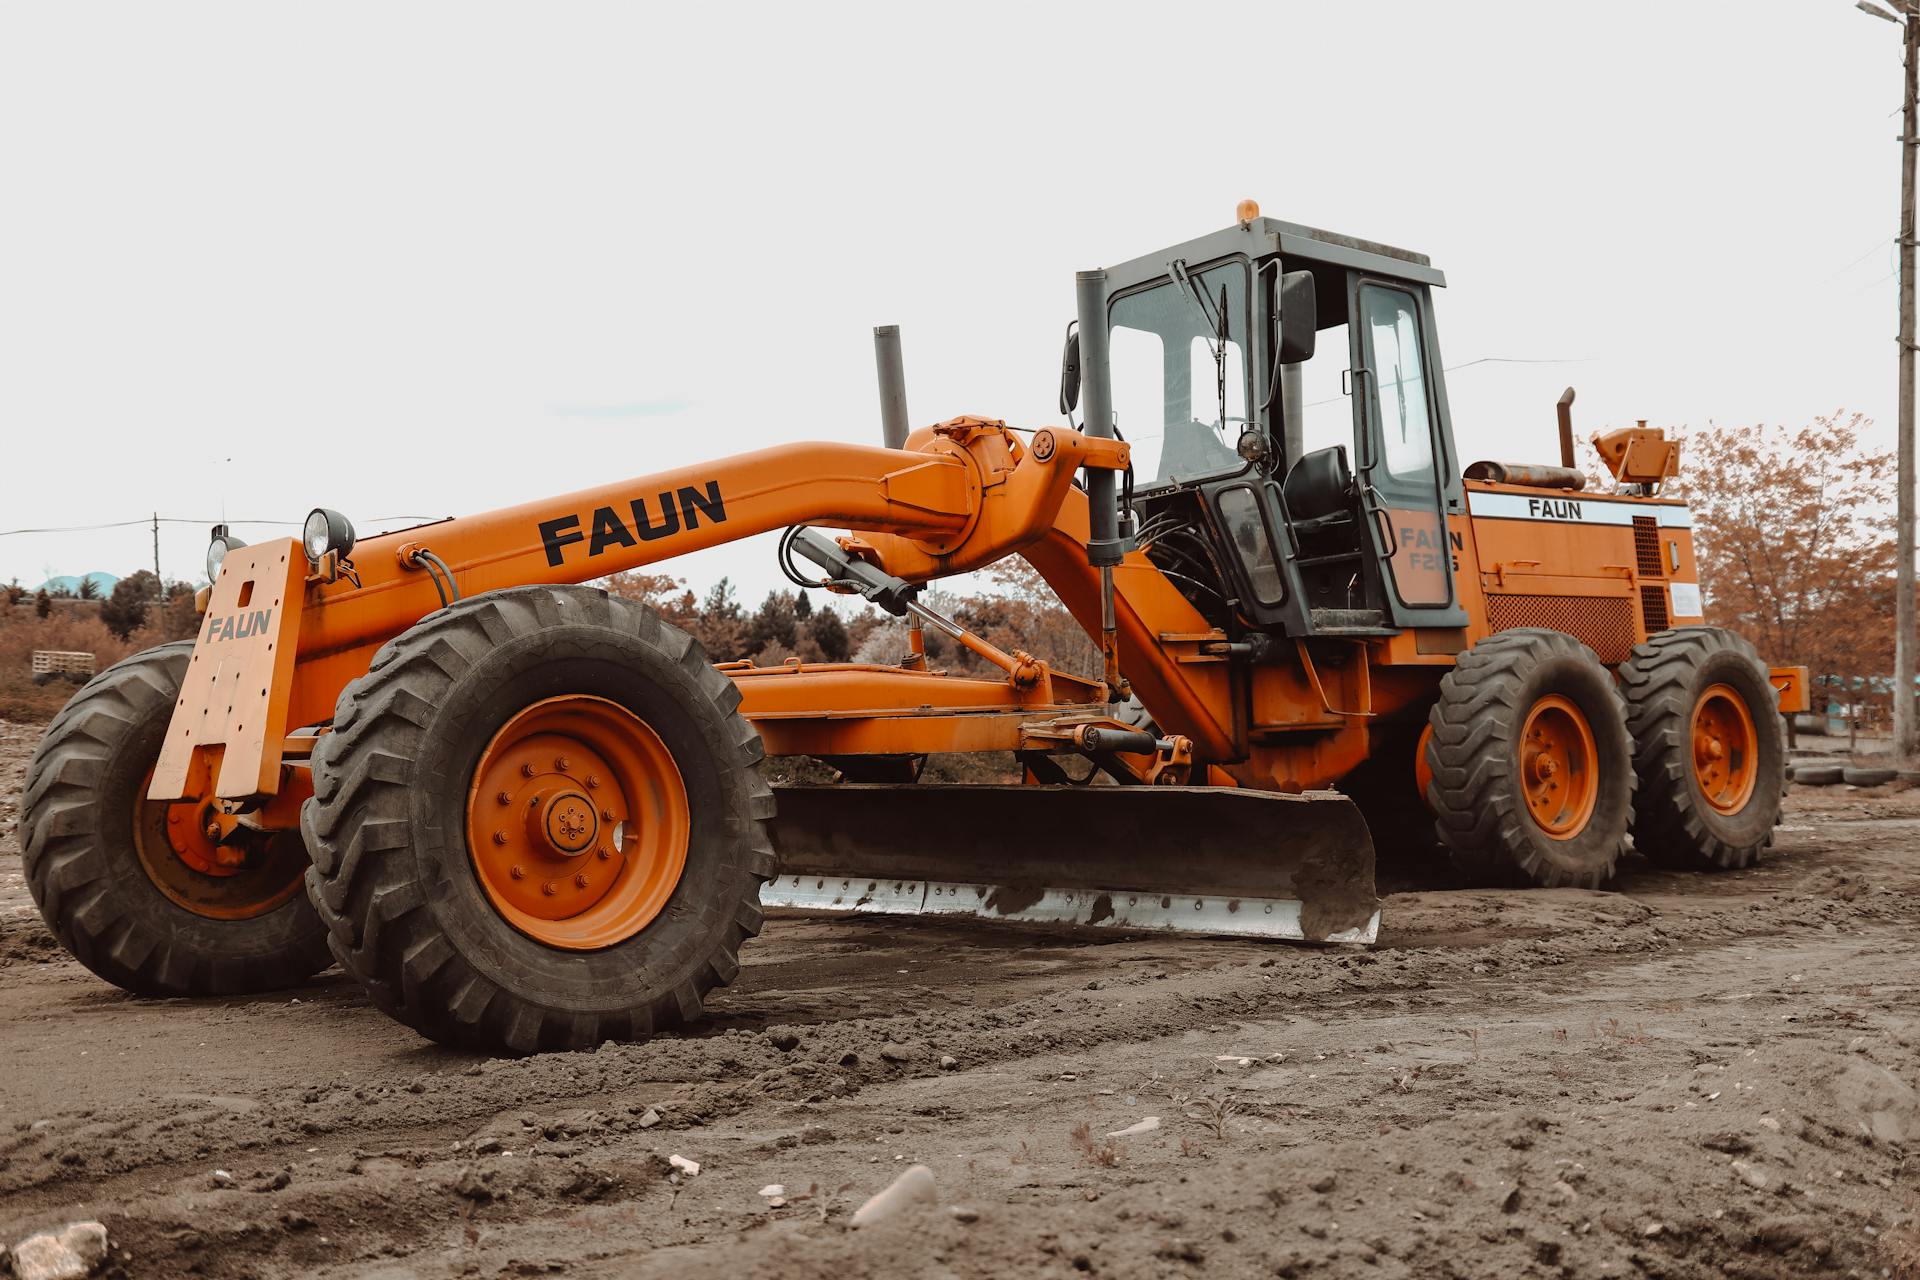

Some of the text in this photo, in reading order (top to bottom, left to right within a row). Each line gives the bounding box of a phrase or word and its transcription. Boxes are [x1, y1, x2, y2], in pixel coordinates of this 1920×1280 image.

[538, 480, 727, 567] FAUN
[1528, 499, 1583, 520] FAUN
[205, 608, 272, 644] FAUN
